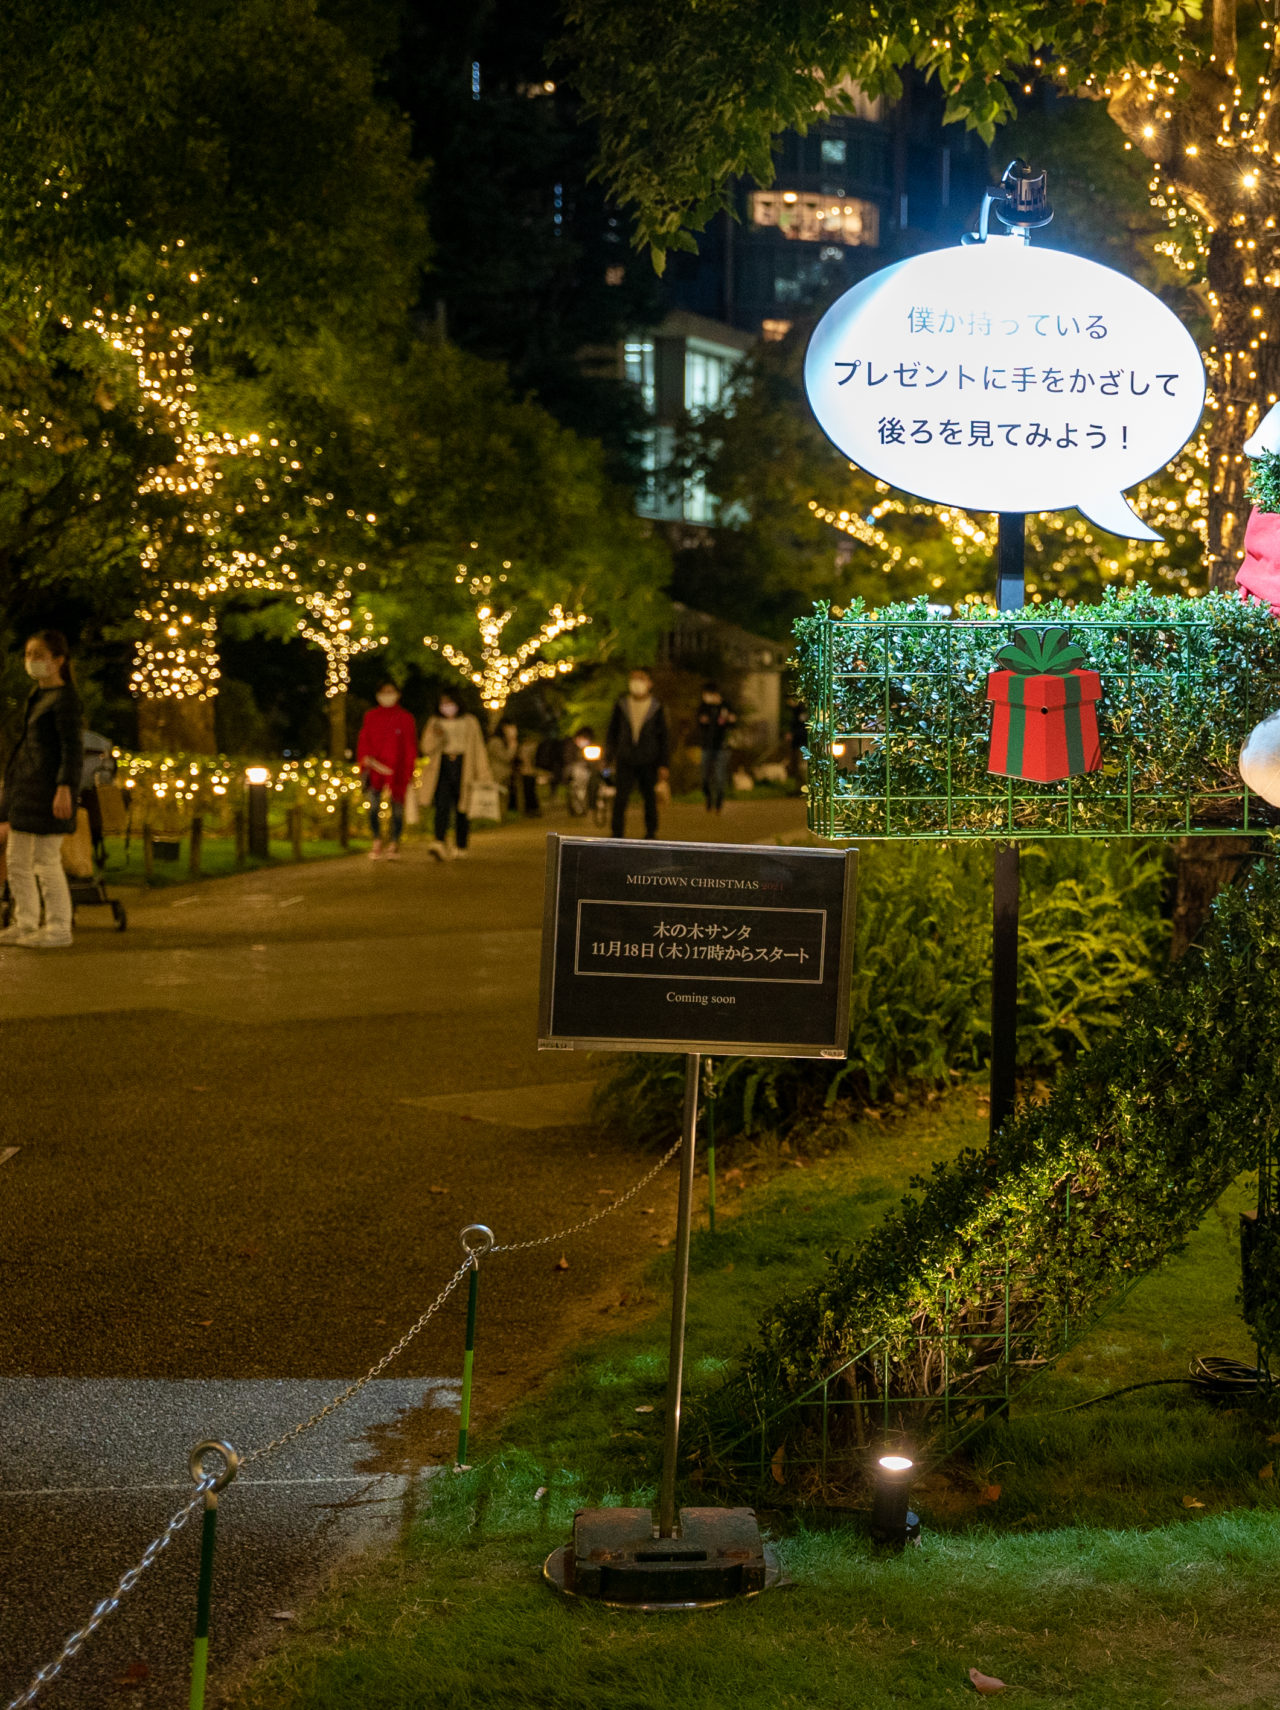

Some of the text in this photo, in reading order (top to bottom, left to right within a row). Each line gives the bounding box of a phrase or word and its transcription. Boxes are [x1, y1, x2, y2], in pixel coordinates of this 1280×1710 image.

[834, 359, 1179, 397] プレゼントに手をかざして
[626, 874, 688, 888] MIDTOWN
[690, 878, 759, 890] CHRISTMAS
[653, 921, 752, 940] 木の木サンタ
[666, 991, 736, 1006] Coming soon
